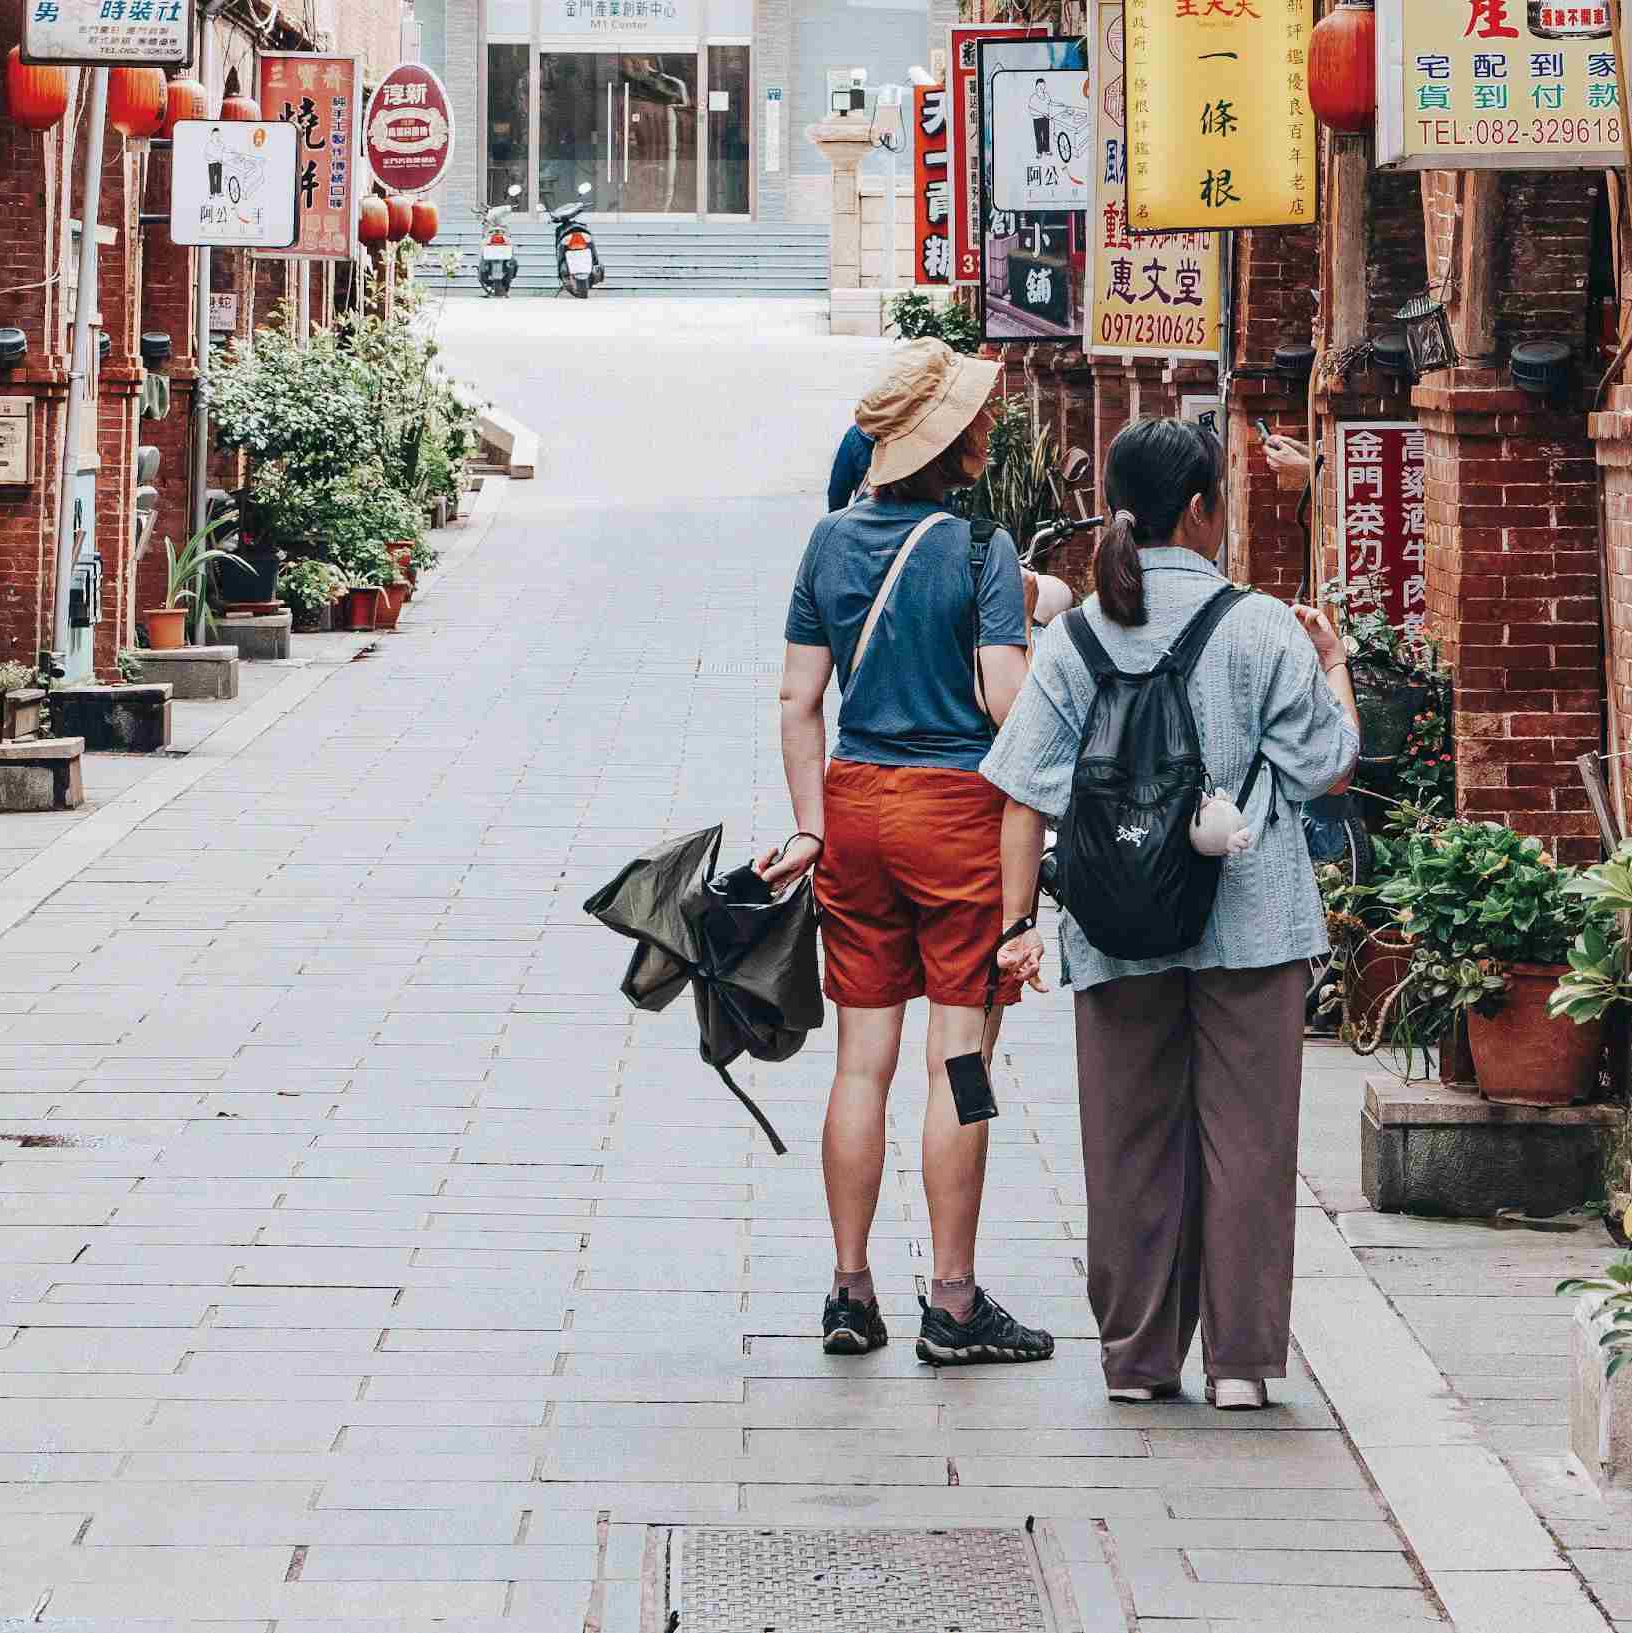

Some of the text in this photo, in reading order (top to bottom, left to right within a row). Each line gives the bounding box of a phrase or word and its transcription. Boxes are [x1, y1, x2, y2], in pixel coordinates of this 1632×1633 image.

[1416, 52, 1617, 79] 宅配到家
[1416, 83, 1620, 111] 貨到付款
[1198, 51, 1242, 210] 一條根
[1106, 257, 1204, 306] 惠文堂
[1101, 313, 1207, 345] 0972310625
